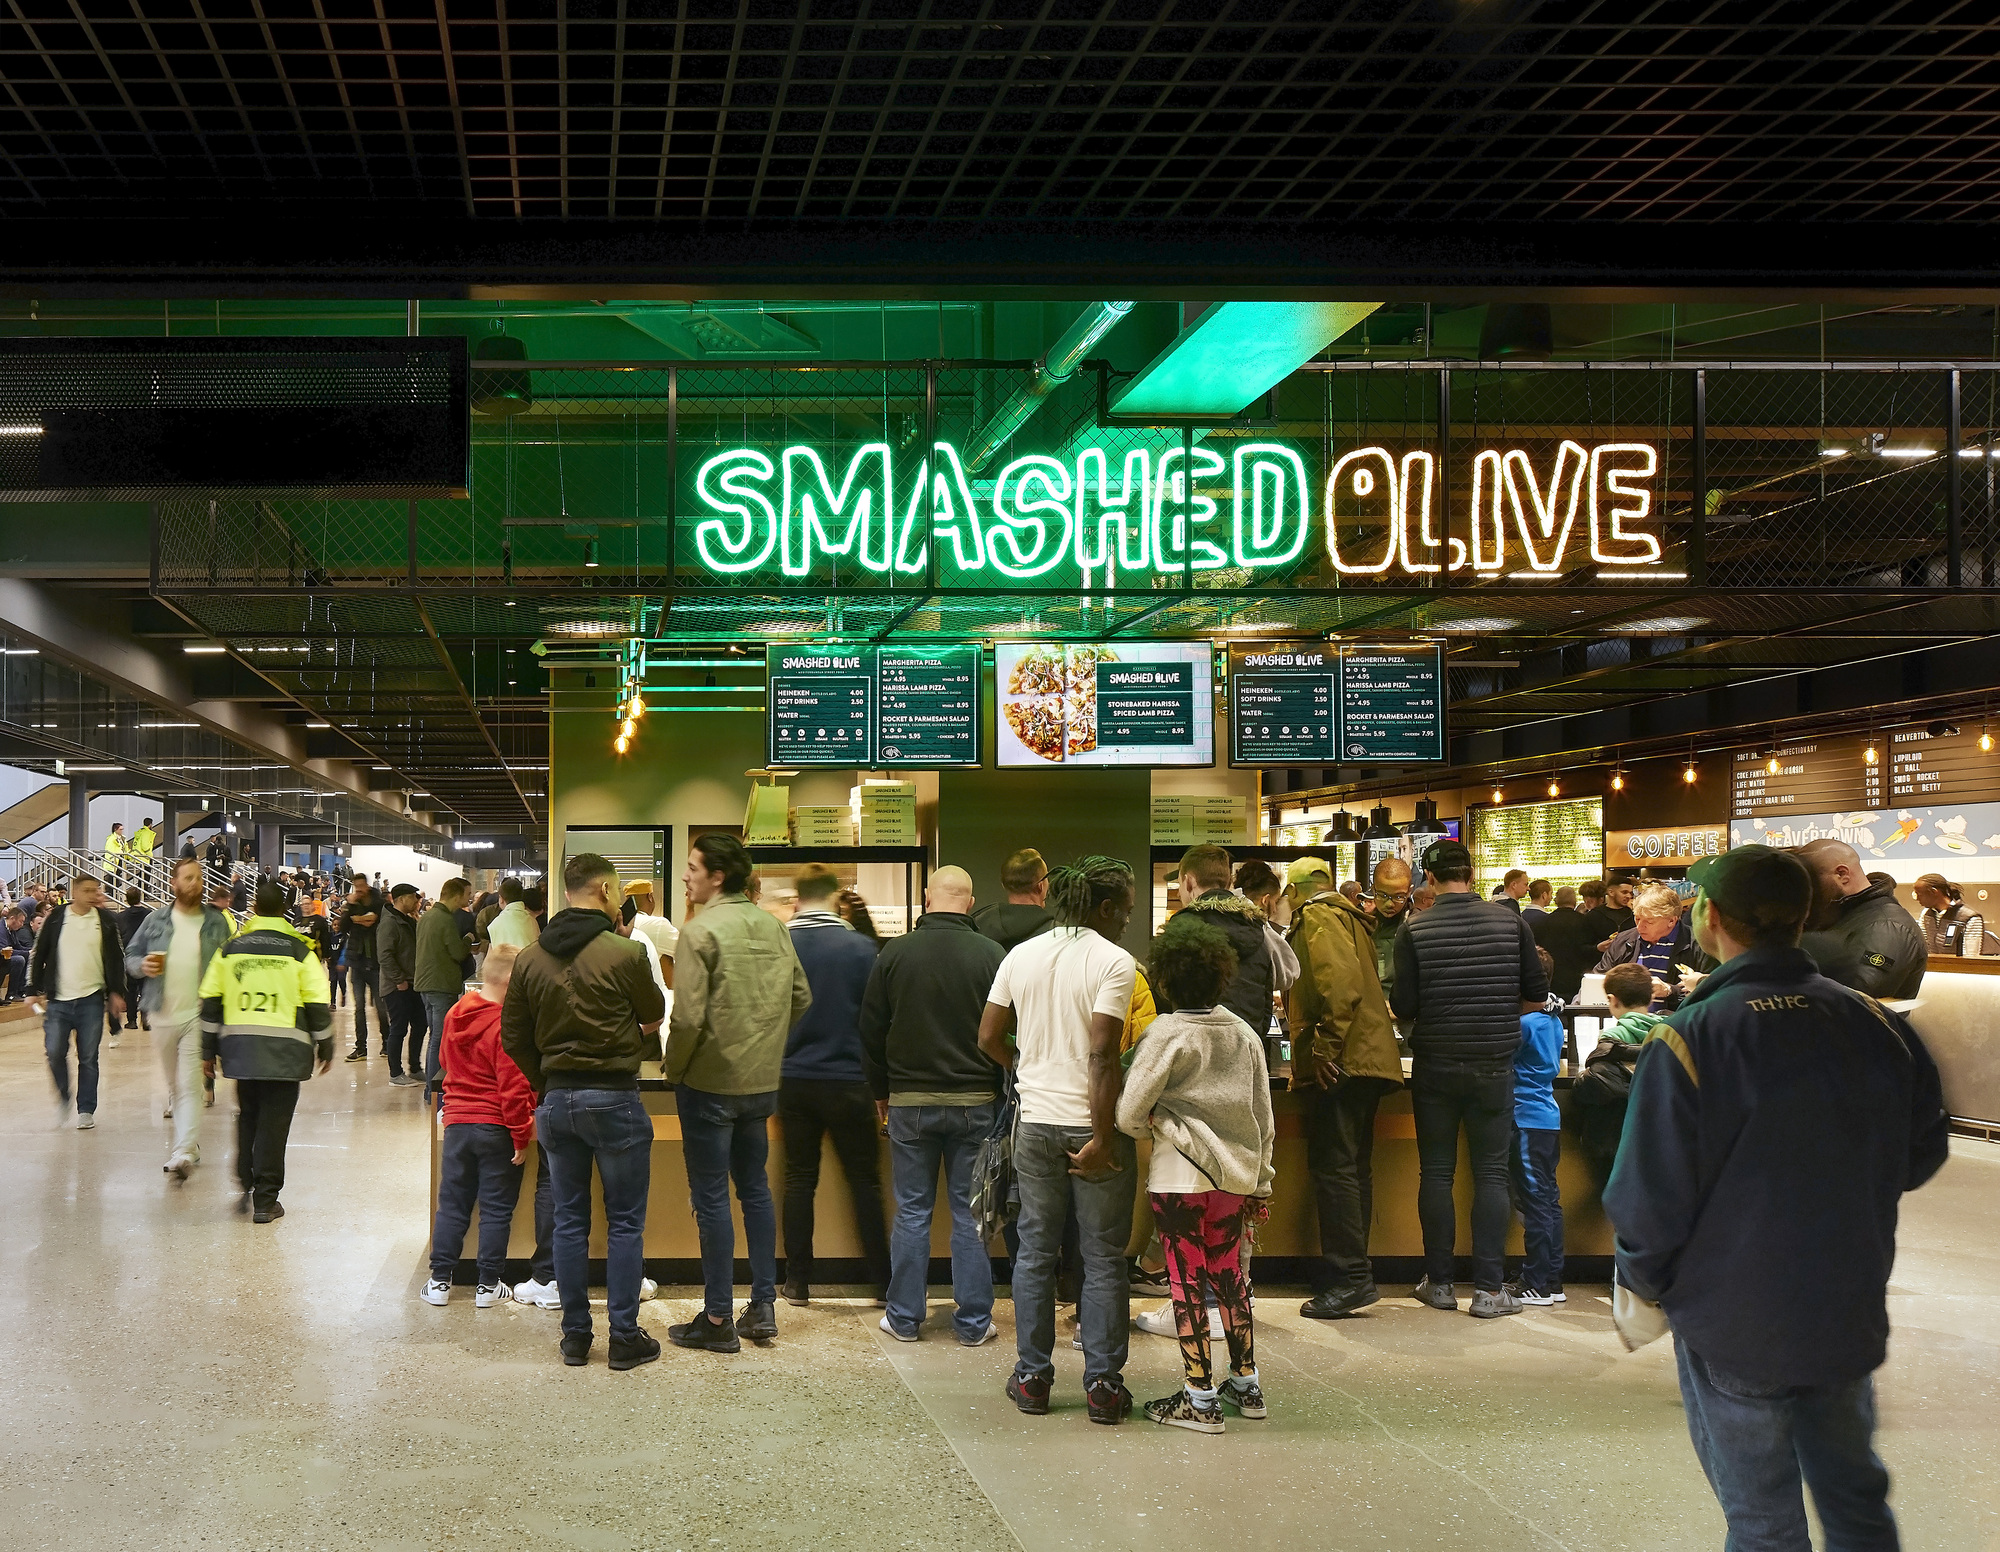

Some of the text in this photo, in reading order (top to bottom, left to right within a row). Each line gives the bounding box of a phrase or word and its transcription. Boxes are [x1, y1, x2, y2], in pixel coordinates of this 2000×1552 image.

[695, 440, 1661, 578] SMASHED OLIVE
[783, 657, 860, 668] SMASHED OLIVE
[1245, 654, 1323, 666] SMASHED OLIVE
[1110, 673, 1180, 683] SMASHED OLIVE
[1737, 752, 1749, 762] SOFT
[1894, 752, 1922, 763] LUPULOID
[1904, 763, 1920, 772] BALL
[1736, 768, 1879, 789] LIFE WATER 2.00
[1894, 772, 1940, 783] SMOG ROCKET
[1736, 778, 1879, 798] HOT DRINKS 2.00
[1894, 783, 1941, 794] BLACK BETTY
[1736, 788, 1880, 807] CHOCOLATE GRAB BAGS 3.50
[1736, 798, 1880, 816] CRISPS 1.50
[1627, 830, 1719, 859] COFFEE
[238, 991, 278, 1013] 021
